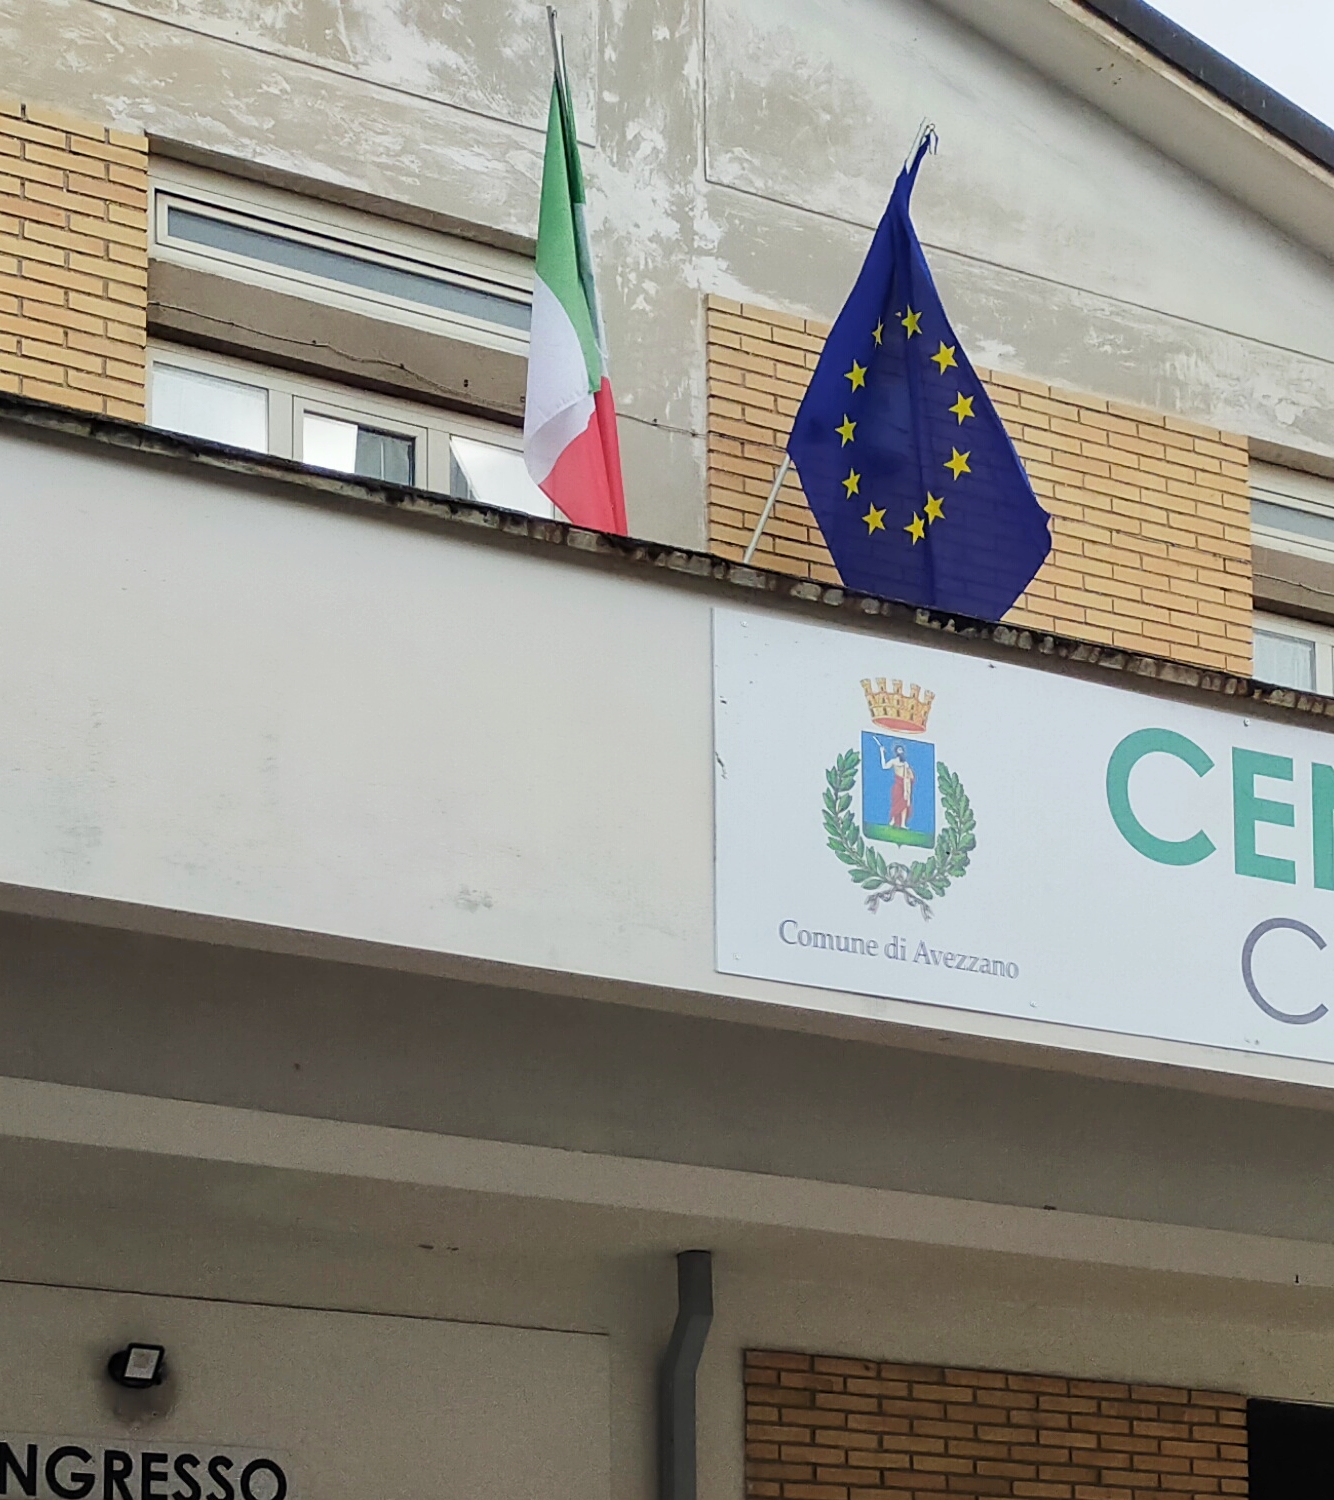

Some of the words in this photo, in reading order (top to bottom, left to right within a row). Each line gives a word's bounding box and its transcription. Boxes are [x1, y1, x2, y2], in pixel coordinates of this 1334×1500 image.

[779, 919, 879, 957] Comune
[879, 935, 907, 961] di
[913, 940, 1020, 979] Avezzano
